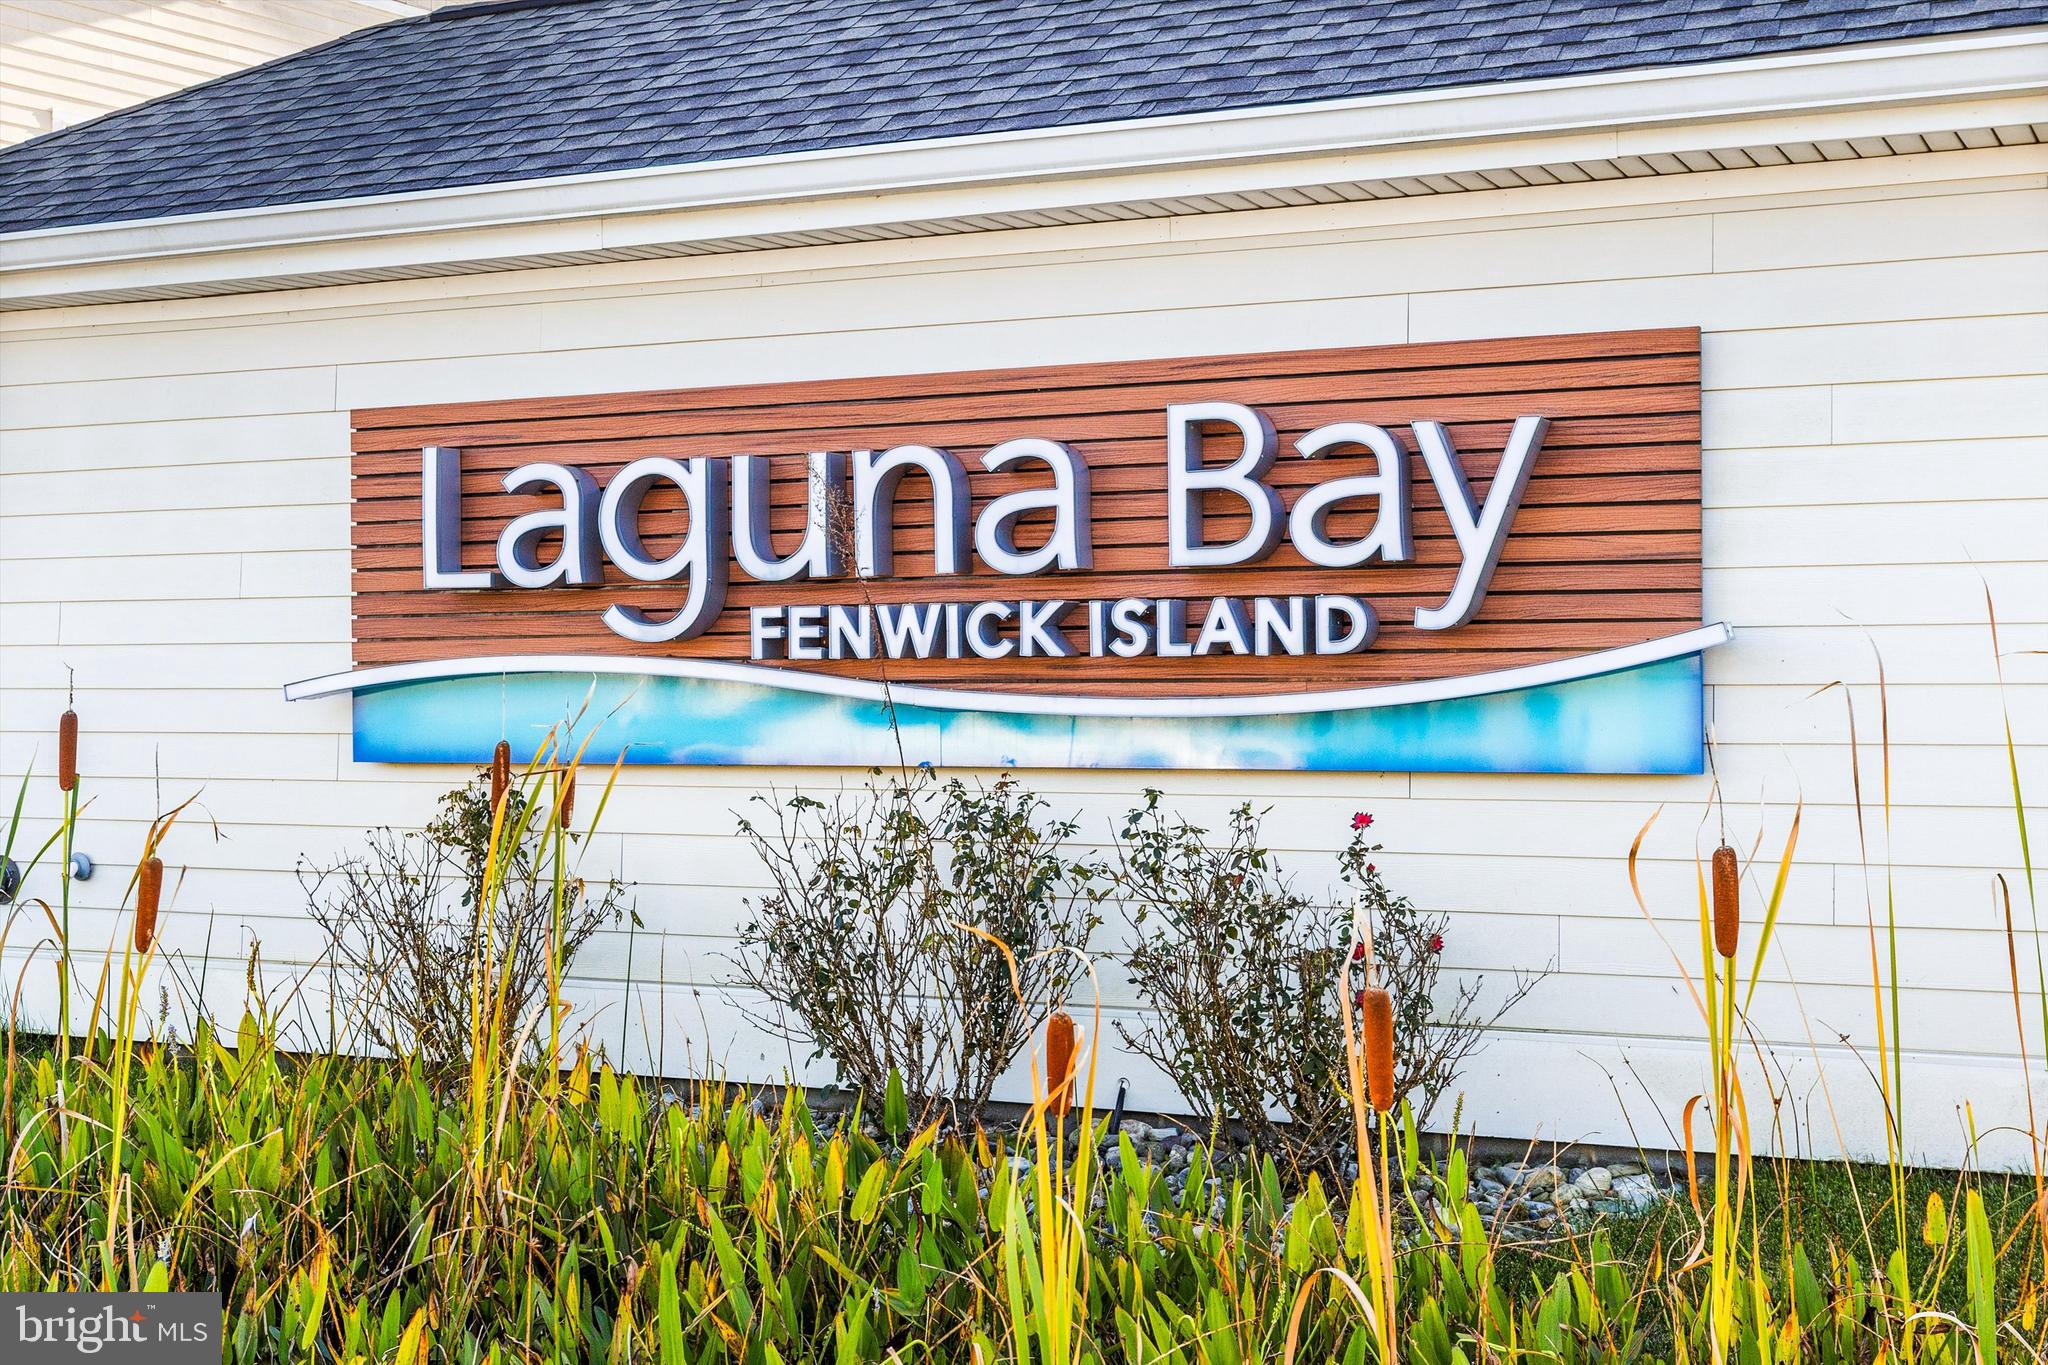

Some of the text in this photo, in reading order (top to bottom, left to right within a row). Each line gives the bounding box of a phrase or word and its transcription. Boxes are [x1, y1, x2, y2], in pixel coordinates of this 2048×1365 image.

[422, 402, 1551, 643] Laguna Bay
[750, 595, 1379, 660] FENWICK ISLAND
